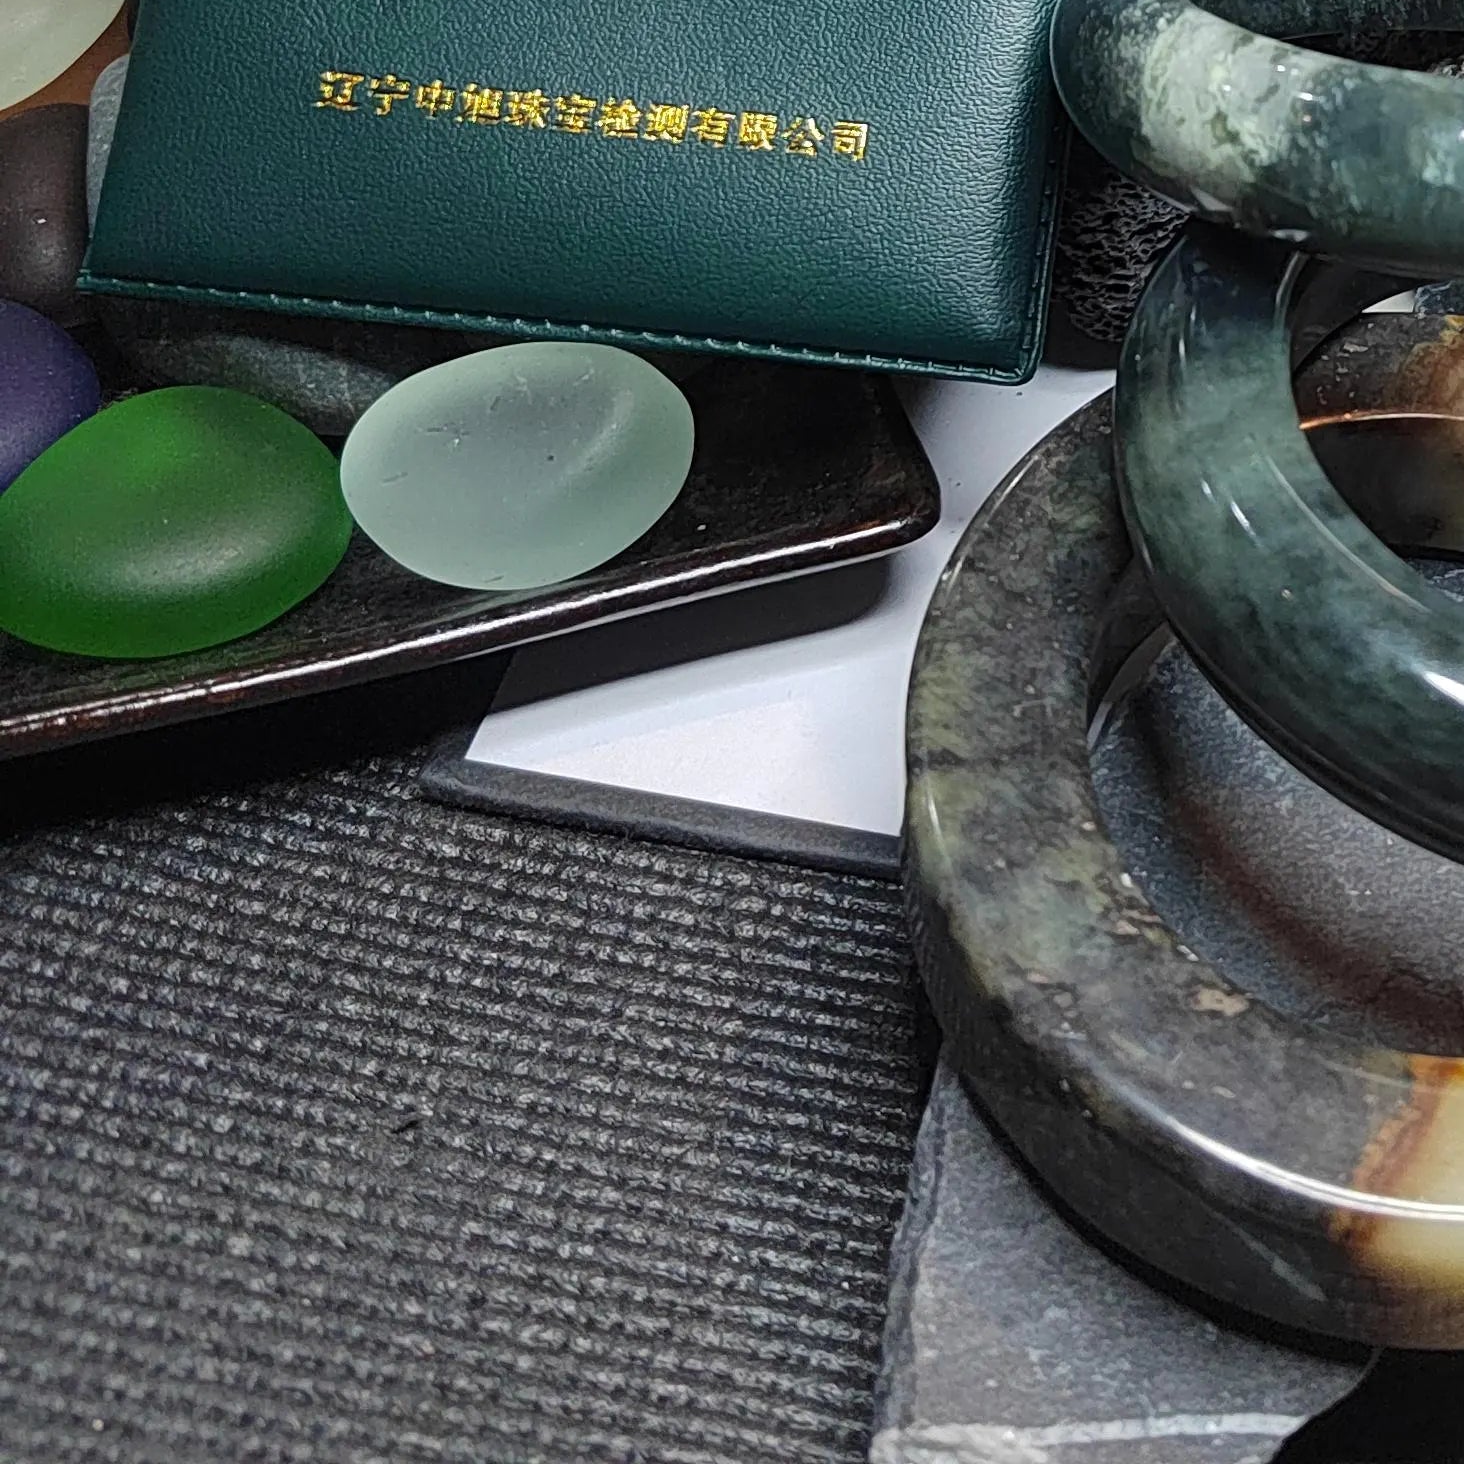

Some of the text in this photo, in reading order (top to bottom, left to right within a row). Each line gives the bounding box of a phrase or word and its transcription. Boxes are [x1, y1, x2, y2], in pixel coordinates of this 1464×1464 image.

[316, 70, 869, 161] 辽宁中旭珠宝检测有限公司
